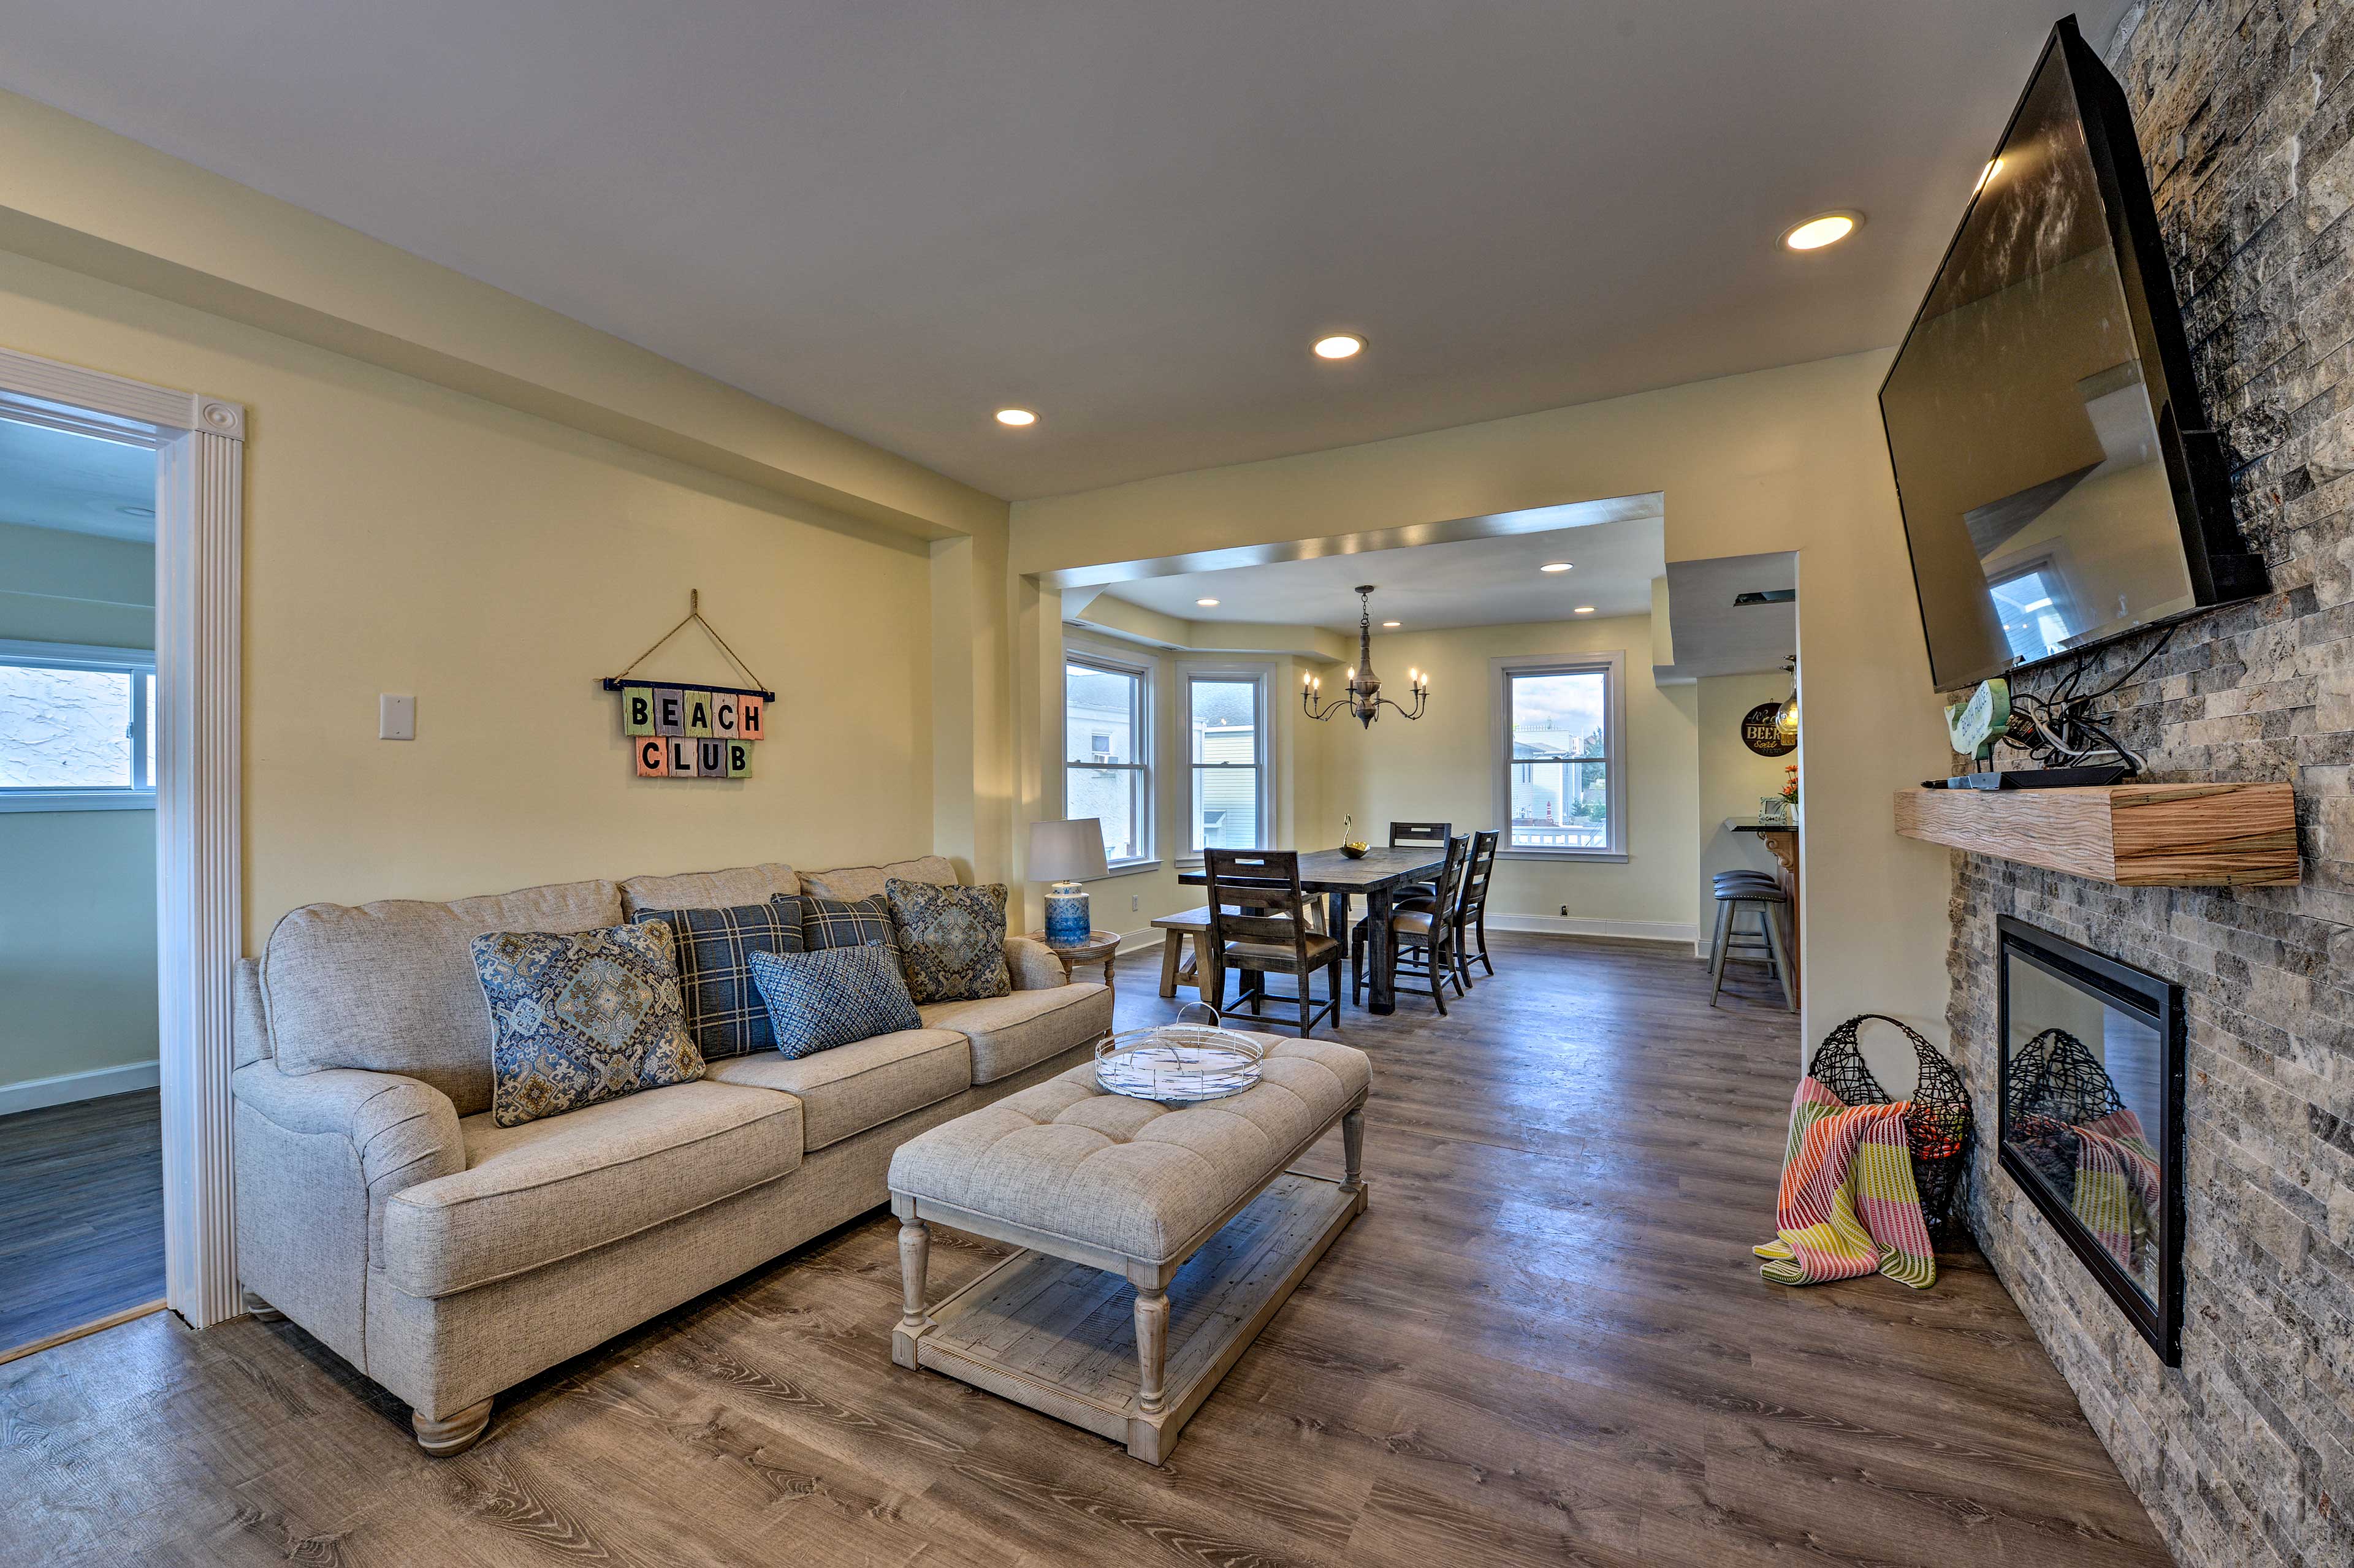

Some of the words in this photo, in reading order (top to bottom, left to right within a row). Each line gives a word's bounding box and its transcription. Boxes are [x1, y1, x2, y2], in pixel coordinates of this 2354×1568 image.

[632, 696, 760, 732] BEACH
[1960, 709, 1974, 737] BEACH
[1746, 726, 1781, 740] BEER
[642, 741, 746, 771] CLUB
